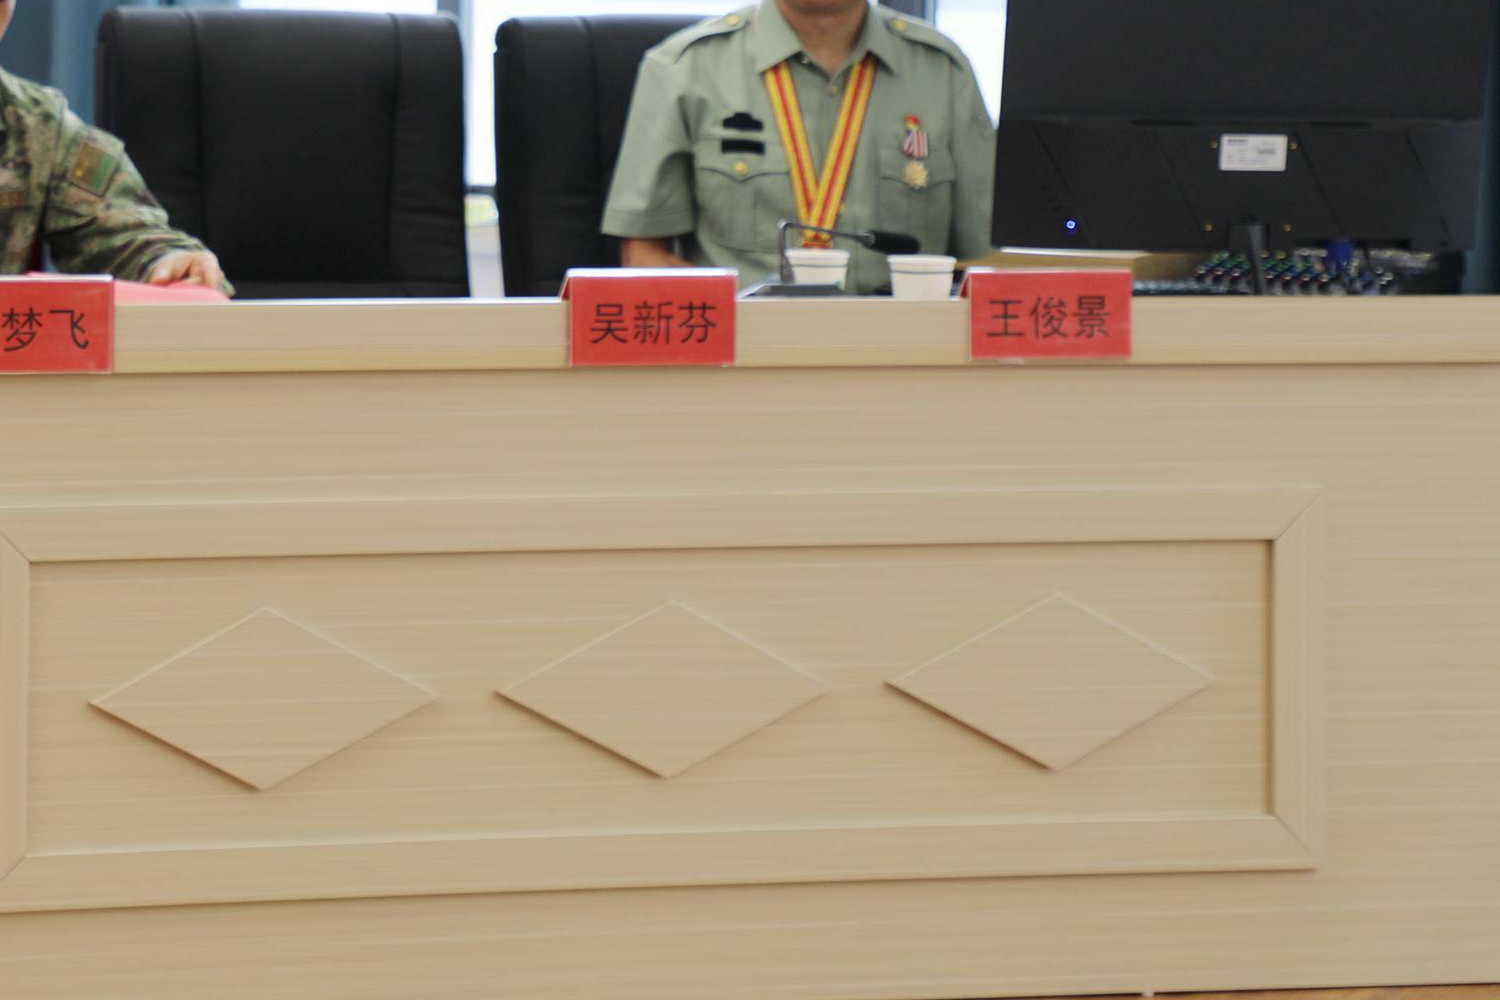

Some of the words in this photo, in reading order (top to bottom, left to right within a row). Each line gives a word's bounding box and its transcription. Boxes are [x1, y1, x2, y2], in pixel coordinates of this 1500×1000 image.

[590, 301, 718, 346] 吴新芬
[986, 296, 1112, 339] 王俊景
